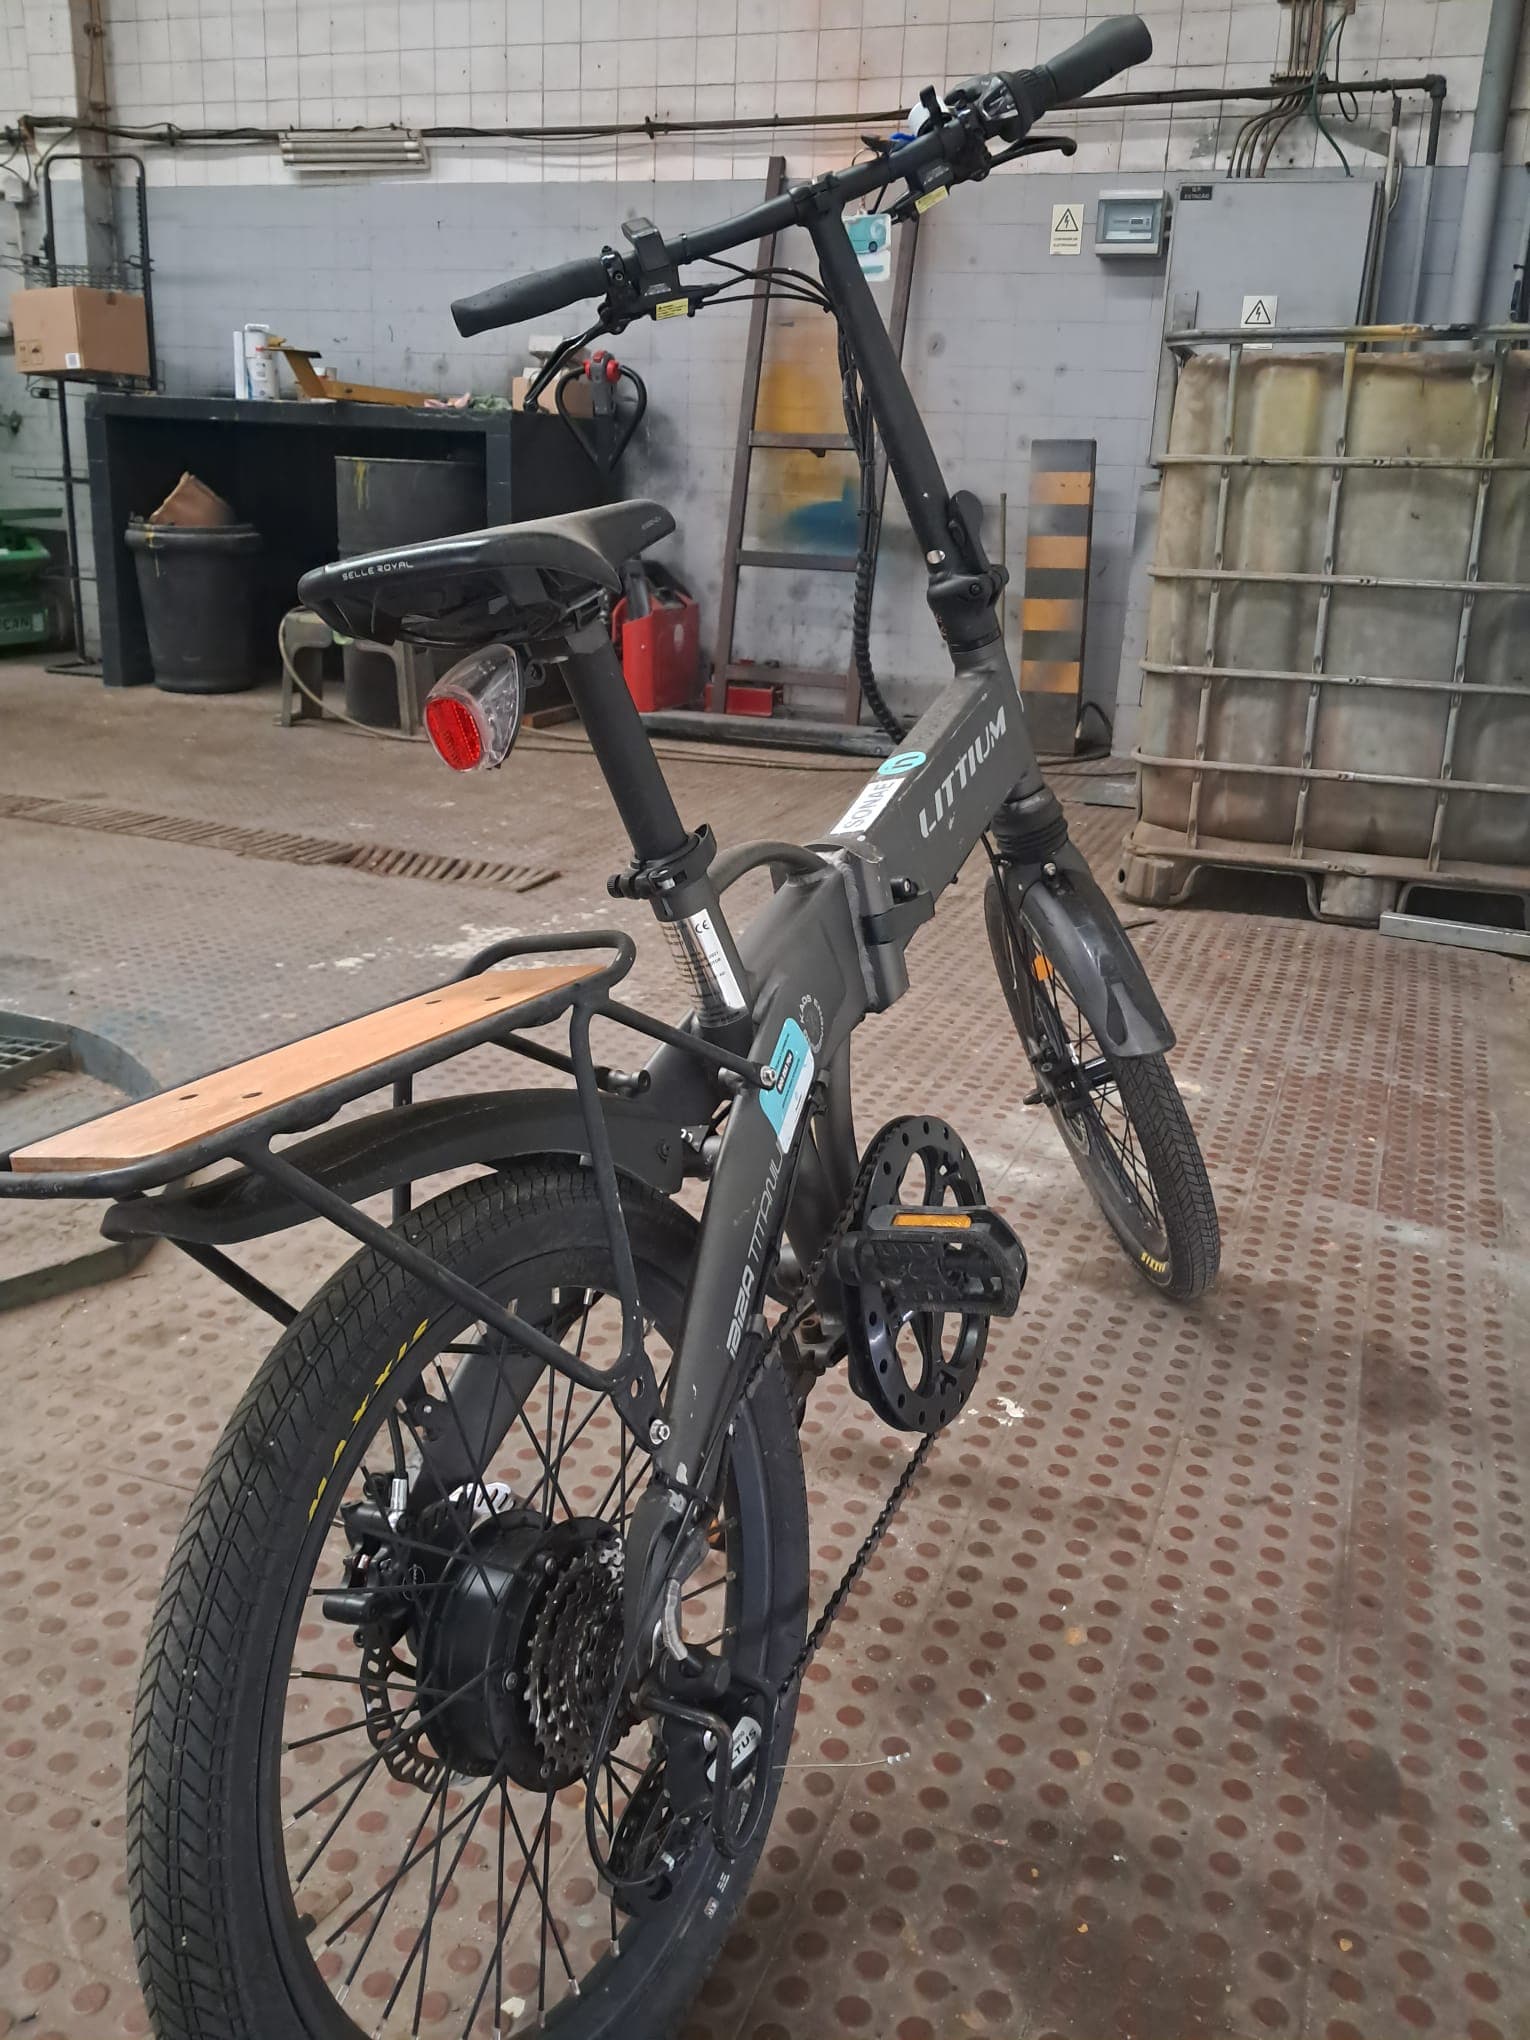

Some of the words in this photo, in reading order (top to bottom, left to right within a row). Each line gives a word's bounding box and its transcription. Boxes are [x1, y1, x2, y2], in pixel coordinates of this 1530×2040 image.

[342, 565, 374, 581] SELLE
[376, 561, 415, 574] ROYAL
[919, 705, 1006, 838] LITTIUM
[843, 781, 895, 829] SONAE
[748, 1141, 783, 1262] TITANIU
[732, 1726, 757, 1761] TUS
